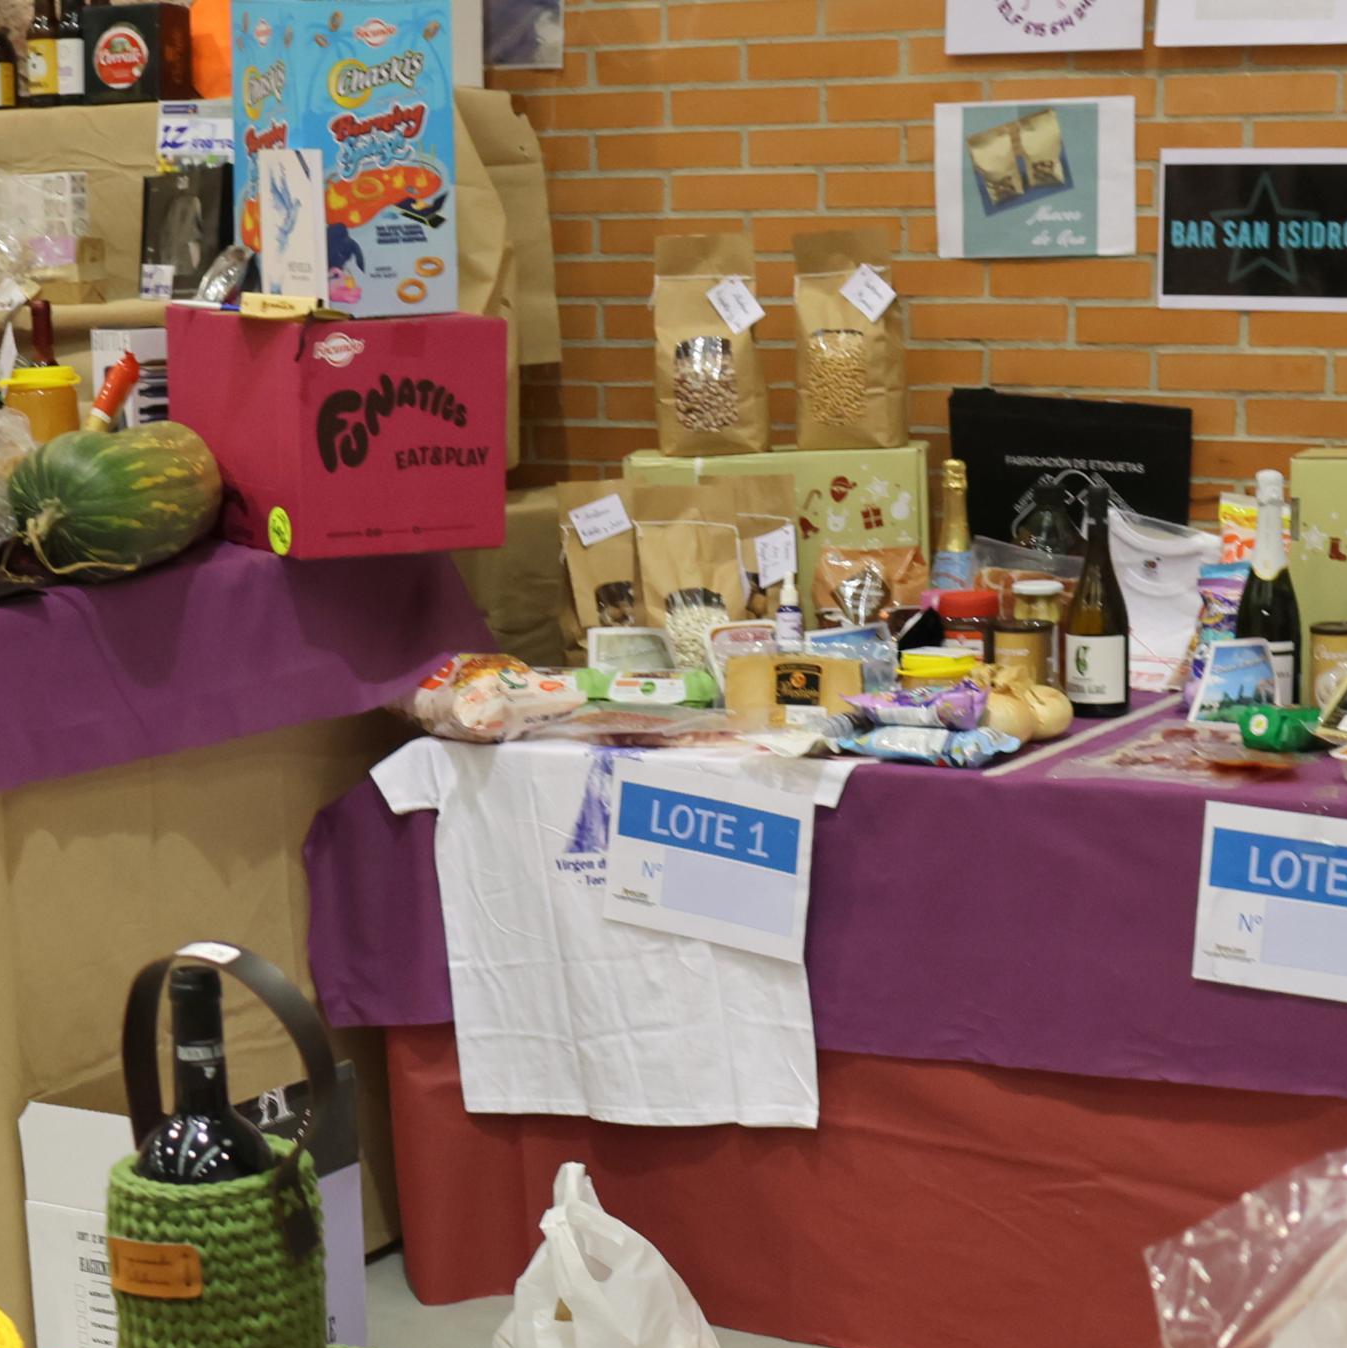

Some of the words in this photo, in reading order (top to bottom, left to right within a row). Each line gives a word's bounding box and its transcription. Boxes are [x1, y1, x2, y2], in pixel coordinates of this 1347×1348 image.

[1171, 219, 1215, 249] BAR
[1223, 220, 1269, 249] SAN
[649, 799, 738, 851] LOTE
[745, 821, 770, 860] 1
